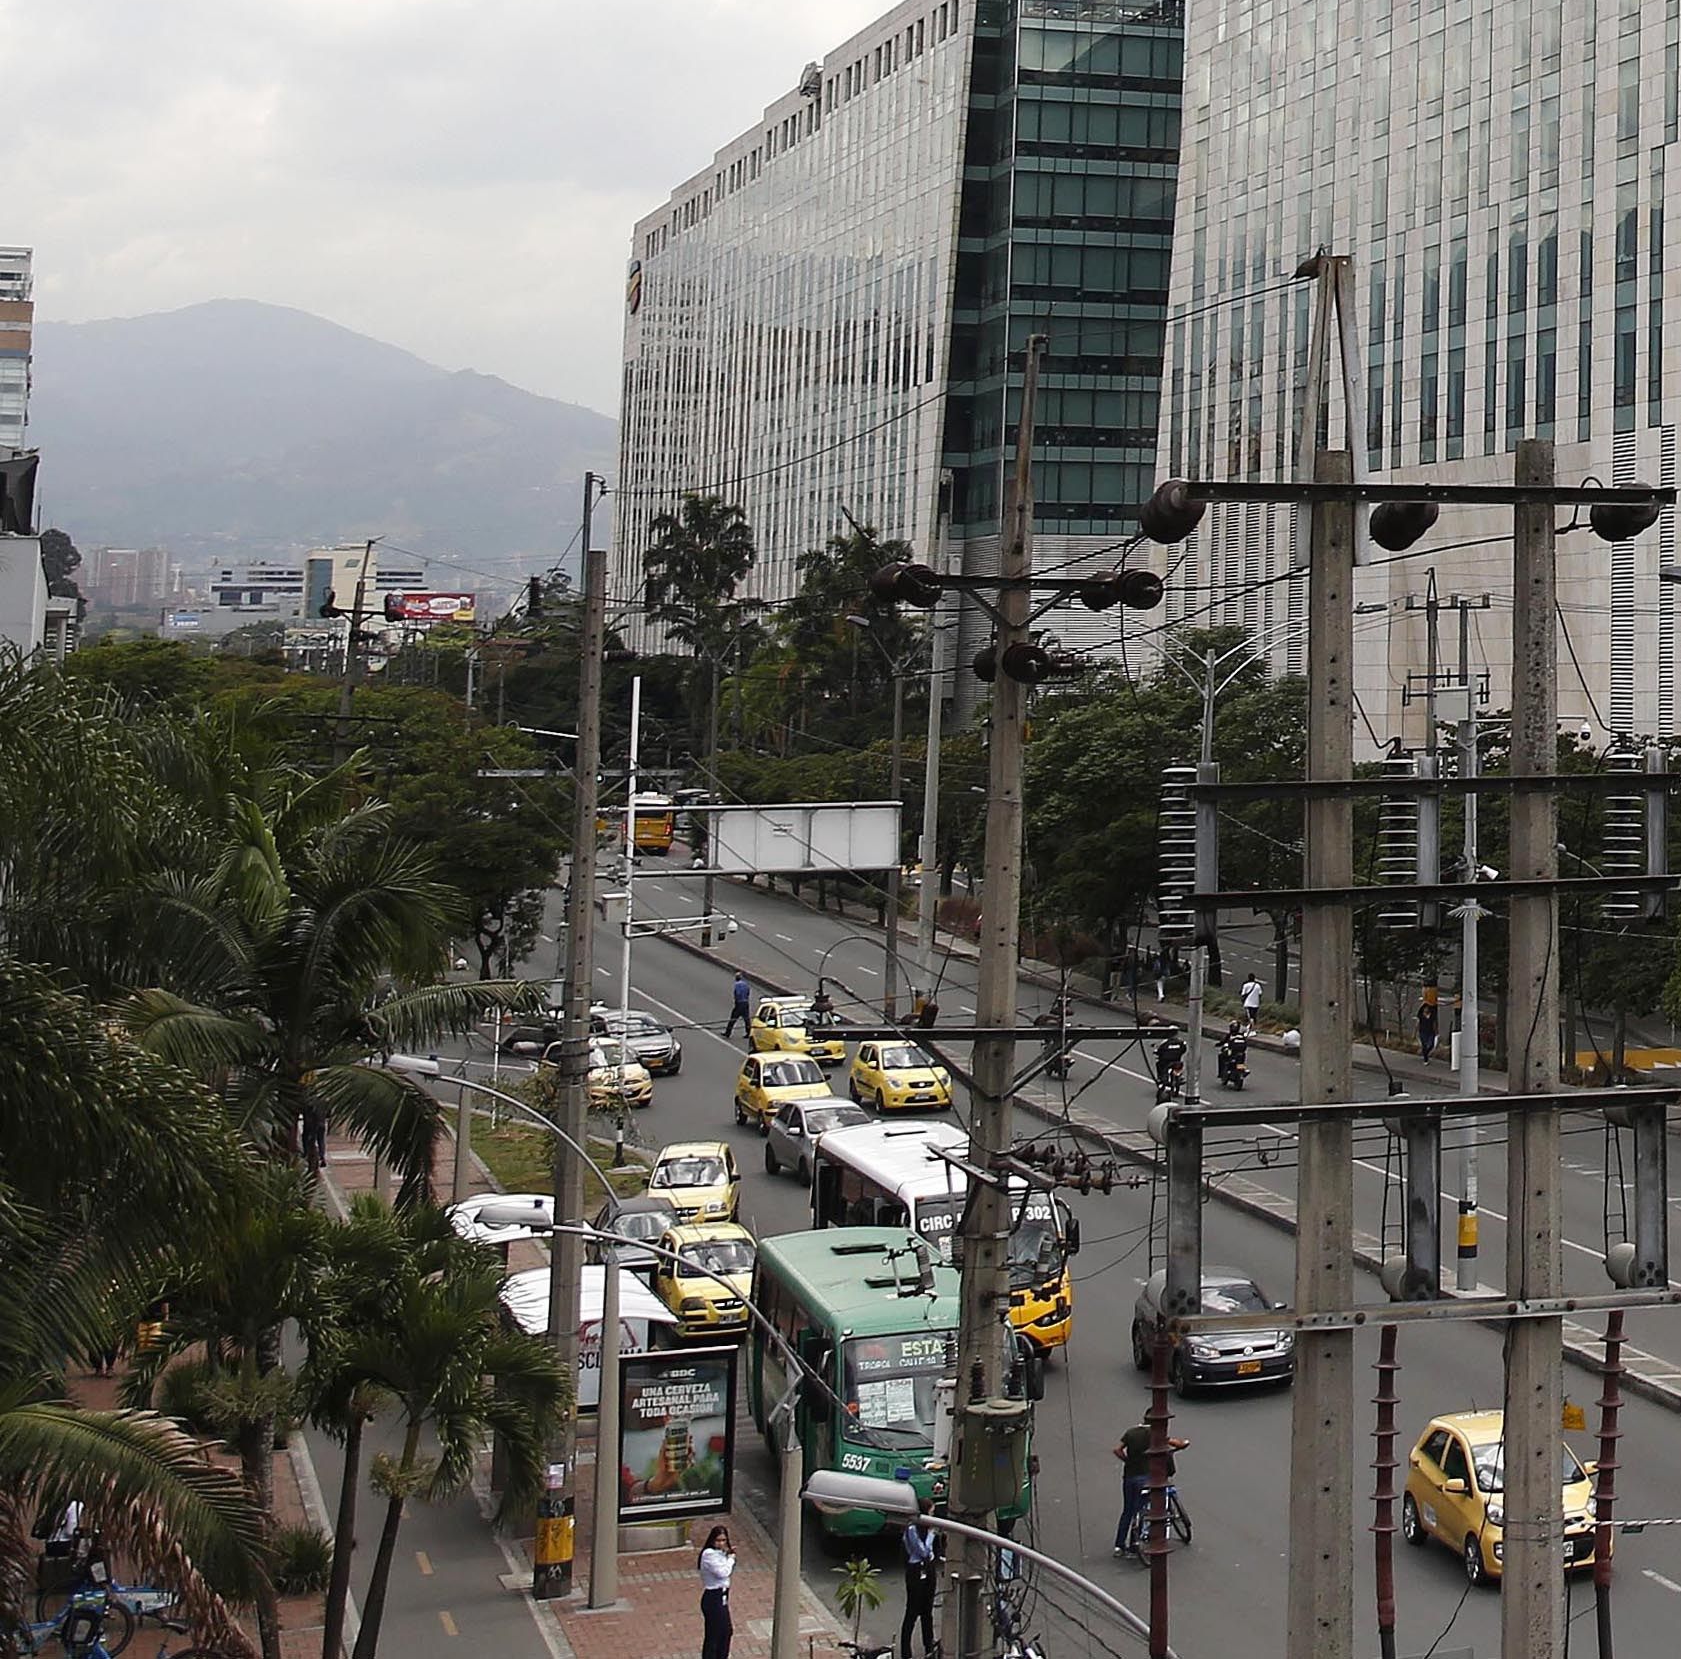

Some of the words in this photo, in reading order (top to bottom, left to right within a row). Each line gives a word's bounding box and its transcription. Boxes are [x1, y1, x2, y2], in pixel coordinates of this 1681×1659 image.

[920, 1214, 953, 1232] CIRC
[1026, 1206, 1051, 1220] 302
[902, 1339, 944, 1357] ESTA
[642, 1387, 663, 1397] UNA
[665, 1383, 711, 1396] CERVEZA
[632, 1395, 692, 1409] ARTESANAL
[693, 1392, 720, 1403] PARA
[640, 1405, 667, 1418] TODA
[842, 1453, 871, 1472] 5537
